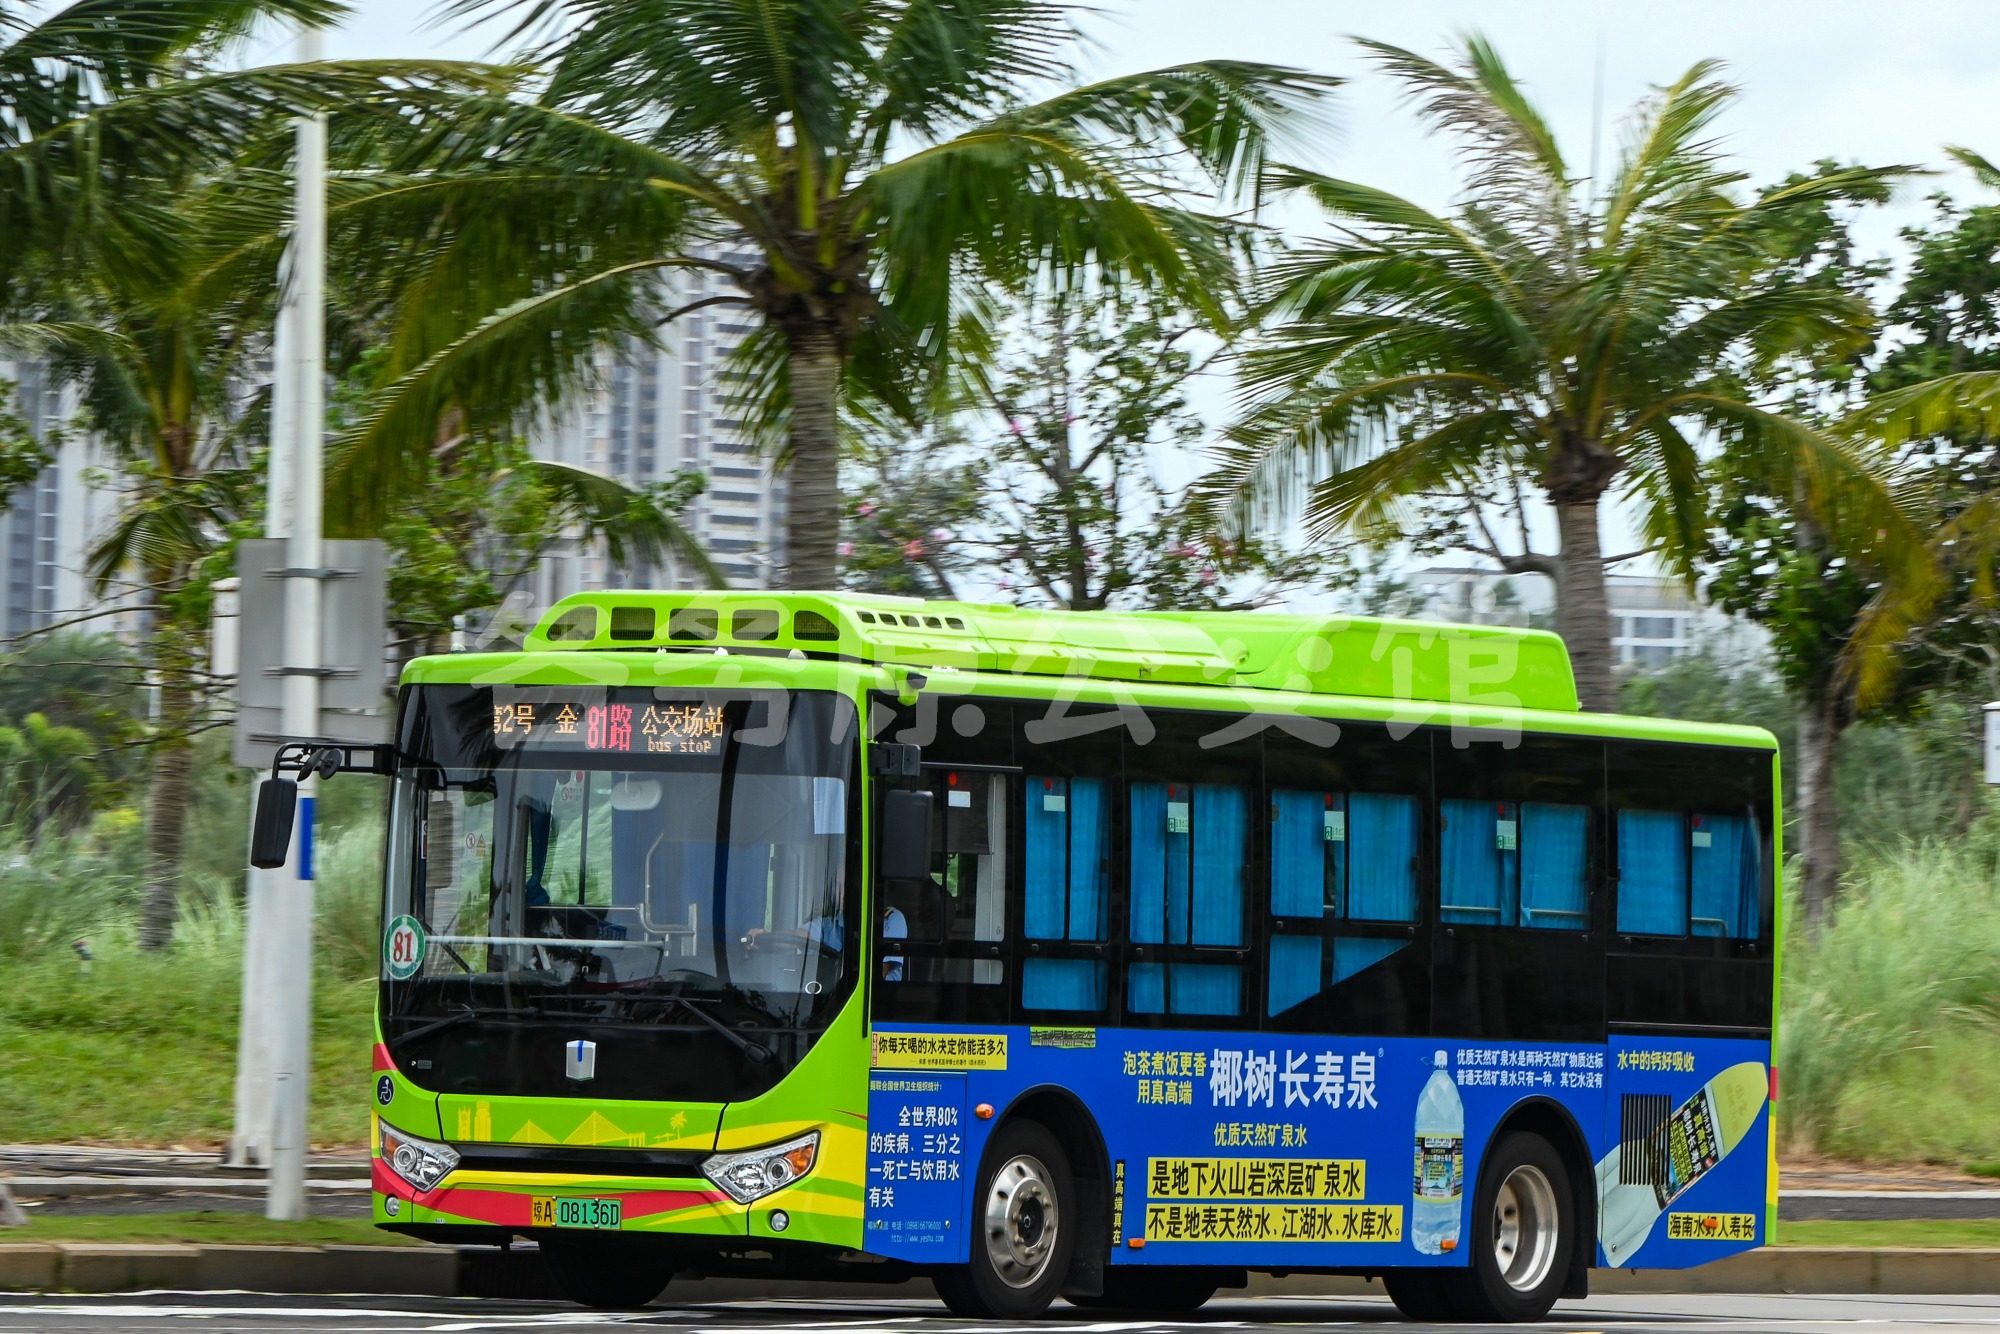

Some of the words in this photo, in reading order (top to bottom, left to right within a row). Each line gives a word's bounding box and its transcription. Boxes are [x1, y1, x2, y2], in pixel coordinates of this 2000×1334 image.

[587, 704, 633, 751] 81路
[640, 705, 723, 737] 公交场站
[648, 737, 672, 753] bus
[394, 931, 412, 962] 81
[878, 1037, 1006, 1056] 你每天喝的水决定你能活多久
[1123, 1051, 1207, 1077] 泡茶煮饭更香
[1457, 1049, 1604, 1068] 优质天然矿泉水是两种天然矿物质达标
[1617, 1050, 1696, 1072] 水中的钙好吸收
[1209, 1048, 1378, 1109] 椰树长寿泉
[1136, 1079, 1193, 1105] 用真高端
[898, 1105, 958, 1127] 全世界80%
[1213, 1122, 1307, 1147] 优质天然矿泉水
[869, 1160, 960, 1181] 一死亡与饮用水
[1151, 1160, 1361, 1197] 是地下火山岩深层矿泉水
[868, 1186, 894, 1208] 有关
[533, 1201, 553, 1222] 琼A
[560, 1202, 620, 1226] 08136D
